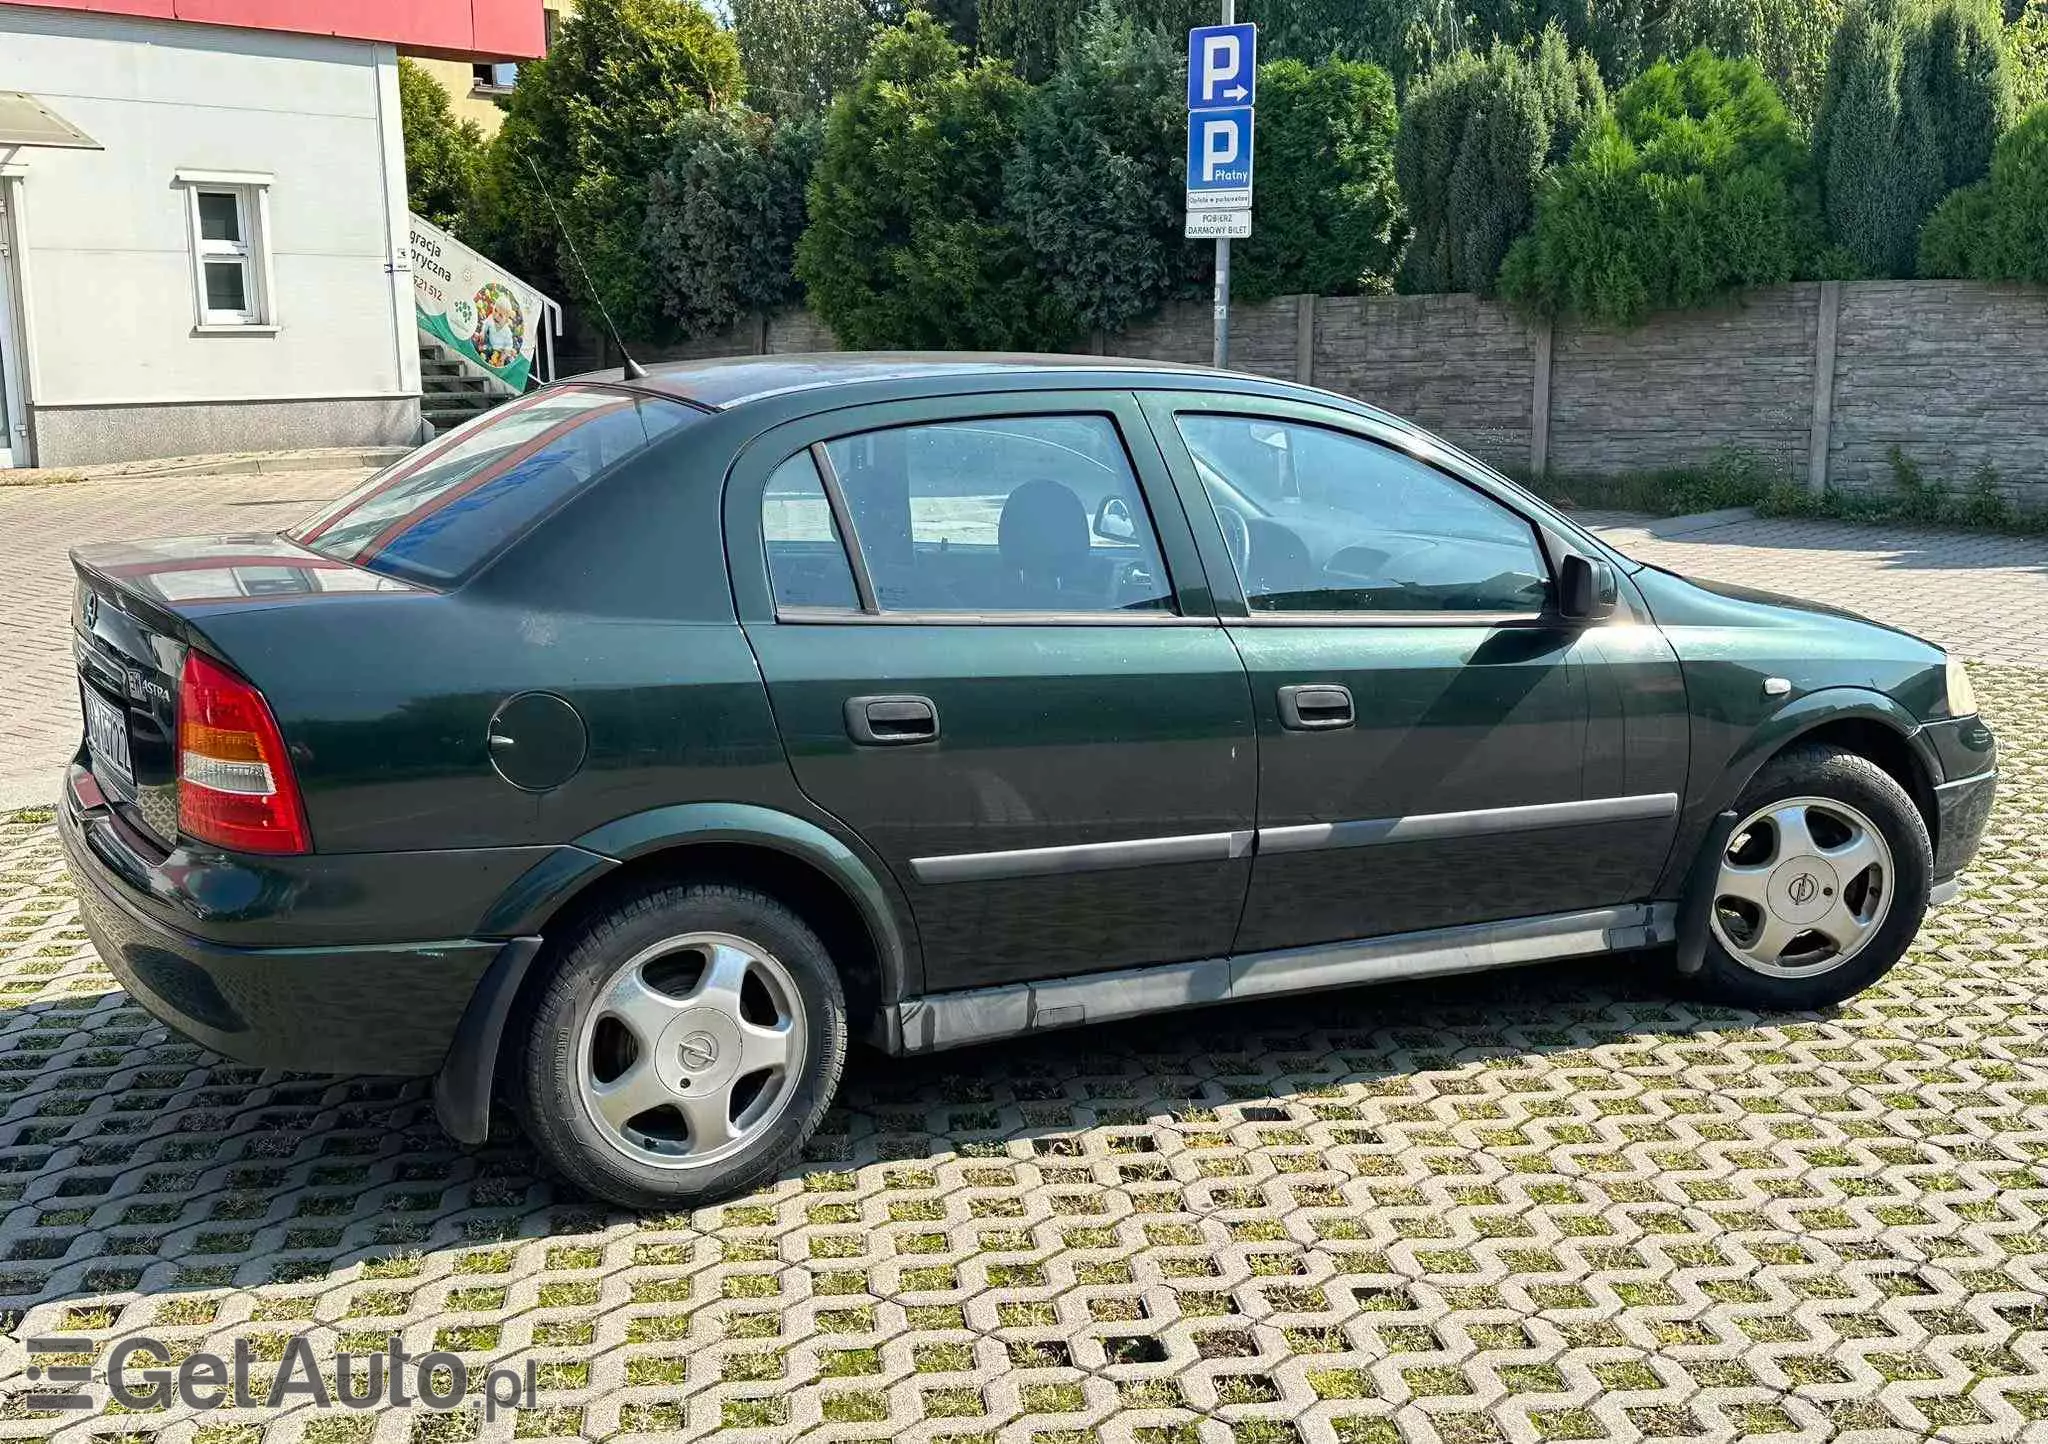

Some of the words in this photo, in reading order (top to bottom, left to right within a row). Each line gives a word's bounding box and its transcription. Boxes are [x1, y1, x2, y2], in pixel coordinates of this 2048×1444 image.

[1203, 35, 1240, 100] P
[1203, 120, 1239, 182] P
[1215, 169, 1248, 183] Płatny
[1228, 225, 1247, 234] BILET
[142, 679, 171, 703] ASTRA
